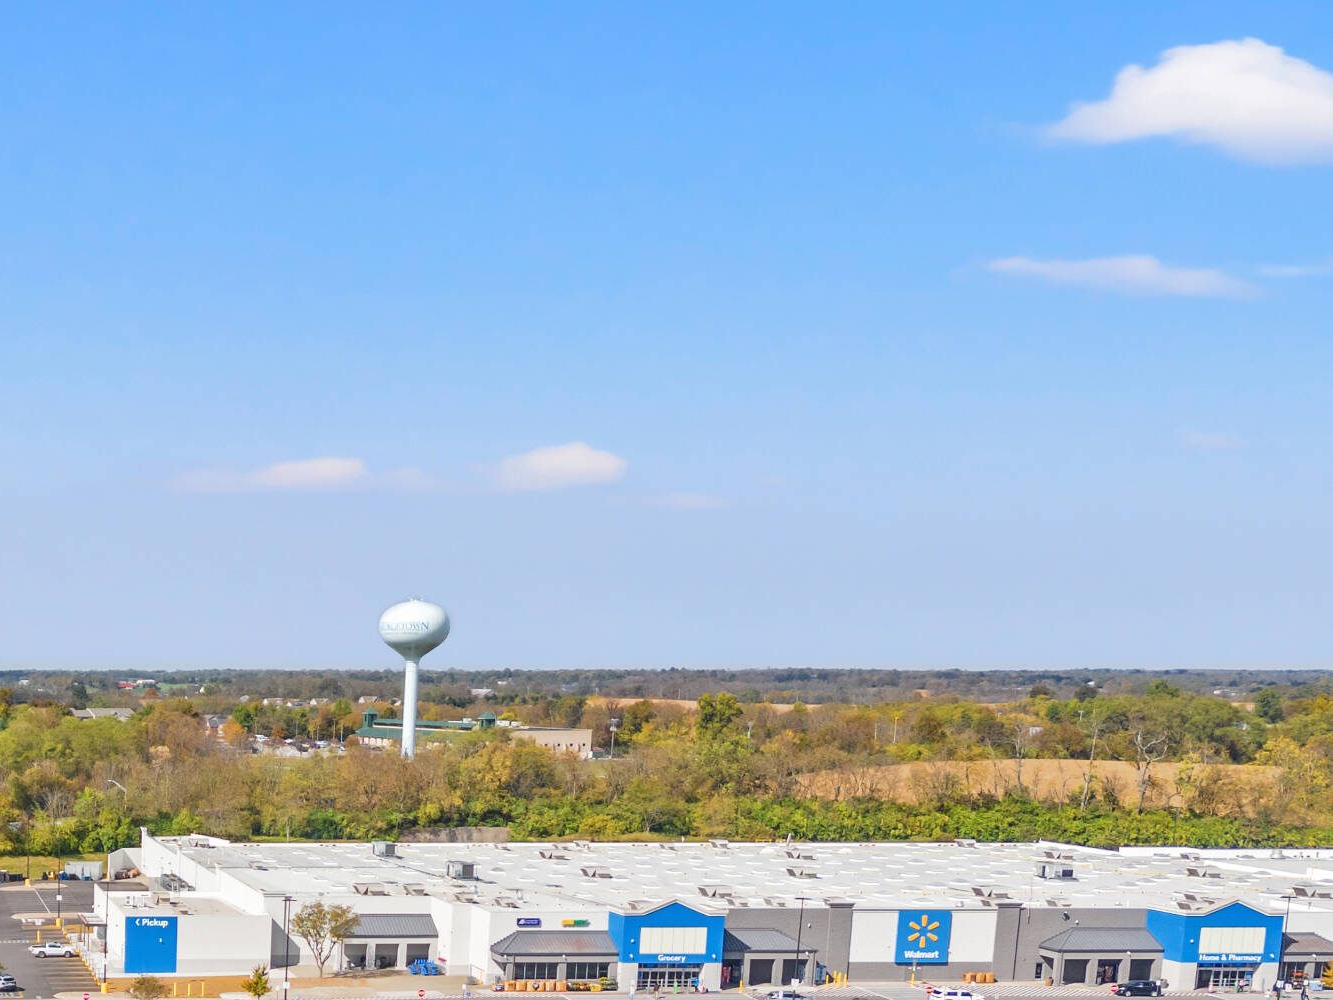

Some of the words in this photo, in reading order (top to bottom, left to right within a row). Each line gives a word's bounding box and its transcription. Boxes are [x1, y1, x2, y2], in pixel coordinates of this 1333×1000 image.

[141, 918, 169, 929] Pickup
[657, 954, 686, 963] Grocery
[904, 950, 939, 959] Walmart
[1228, 954, 1262, 962] Pharmacy
